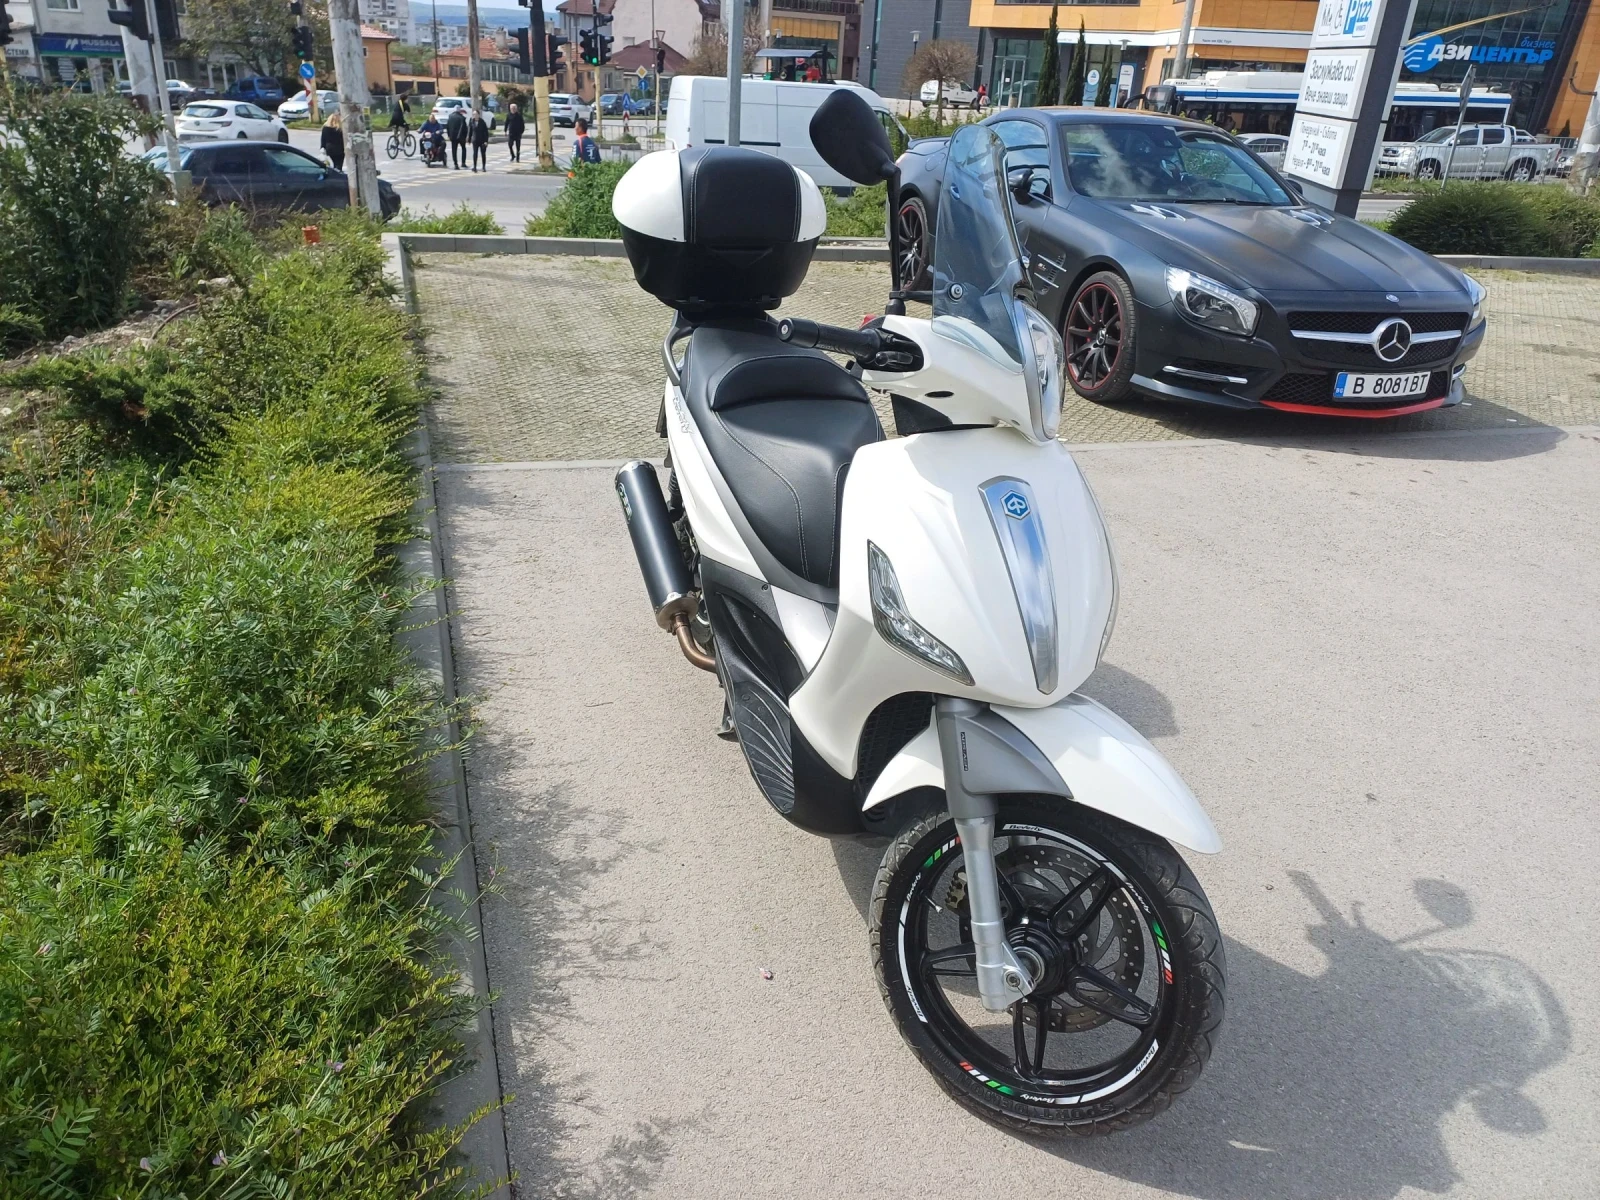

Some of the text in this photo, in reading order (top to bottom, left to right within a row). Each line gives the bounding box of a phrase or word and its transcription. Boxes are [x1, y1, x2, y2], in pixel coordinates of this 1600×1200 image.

[1521, 36, 1556, 49] бизнес
[1310, 59, 1344, 85] Заслужава
[1009, 824, 1044, 832] Beverly
[1125, 882, 1152, 915] Beverly
[1134, 1045, 1156, 1075] Beverly
[1019, 1093, 1055, 1104] Beverly
